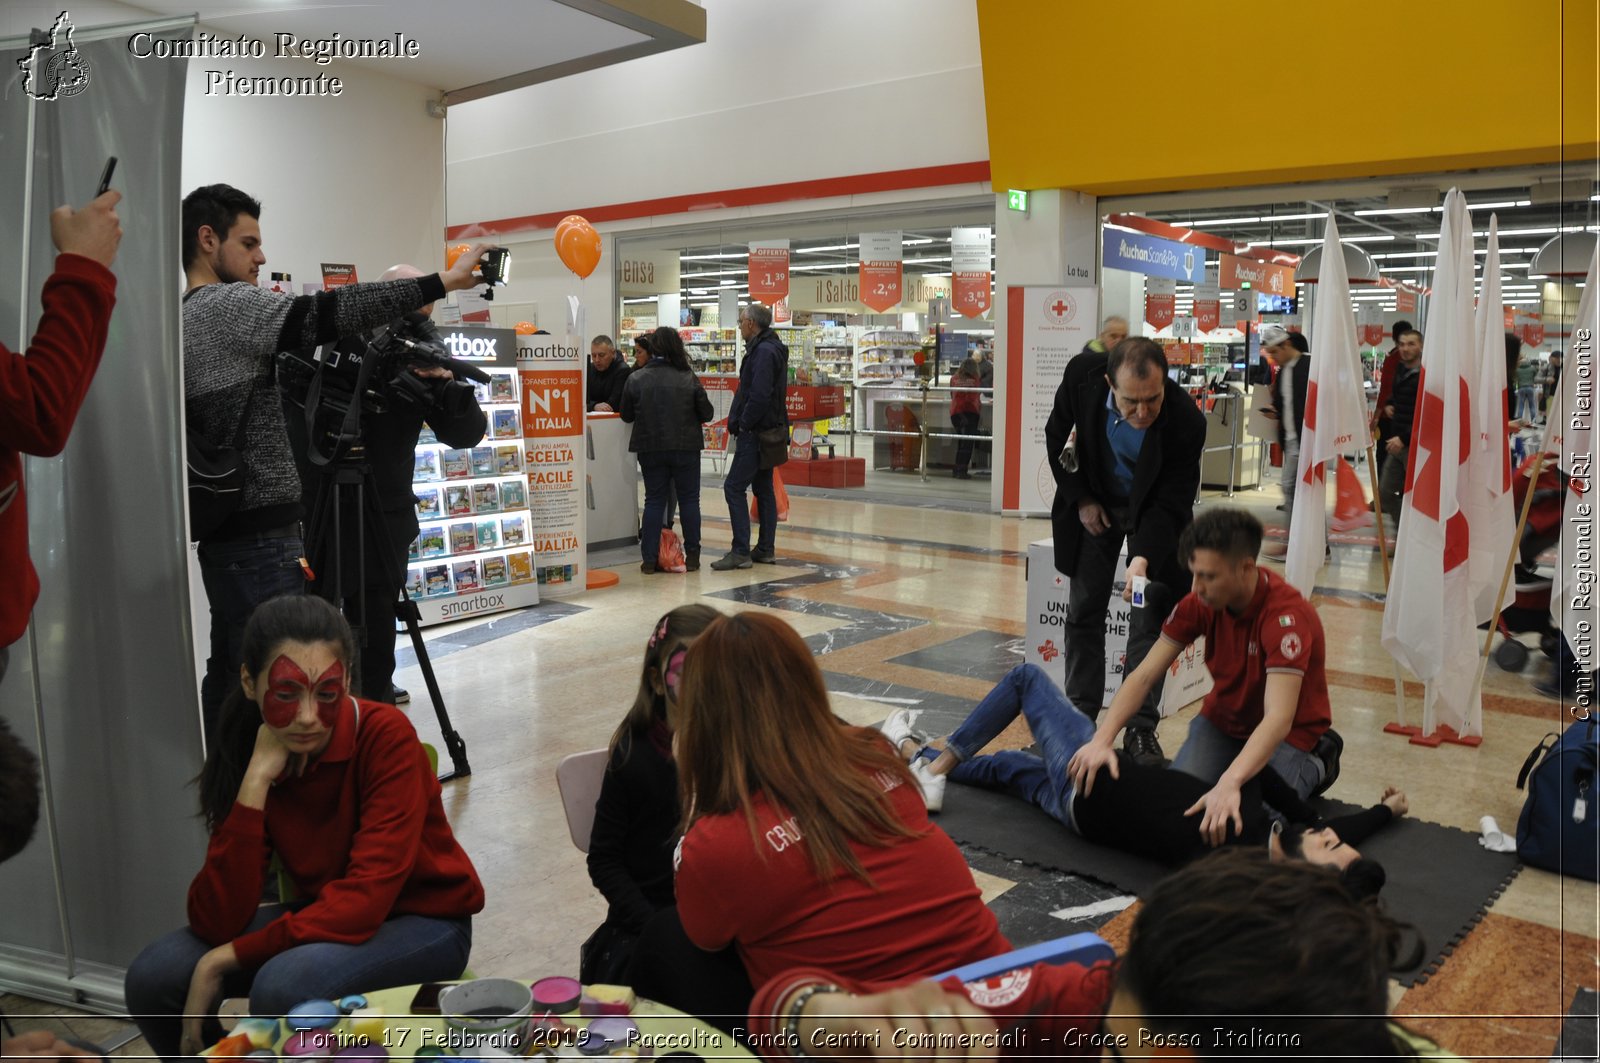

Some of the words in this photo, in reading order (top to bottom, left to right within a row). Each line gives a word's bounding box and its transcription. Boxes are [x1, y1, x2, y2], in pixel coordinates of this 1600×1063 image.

[757, 248, 788, 256] OFFERTA
[871, 260, 898, 268] OFFERTA
[1067, 264, 1076, 276] La
[1077, 266, 1089, 278] tua
[816, 280, 823, 303] il
[1238, 298, 1248, 312] 3
[553, 442, 569, 450] AMPIA
[526, 450, 574, 463] SCELTA
[528, 470, 573, 485] FACILE
[540, 483, 572, 491] UTILIZZARE
[441, 594, 505, 617] smartbox
